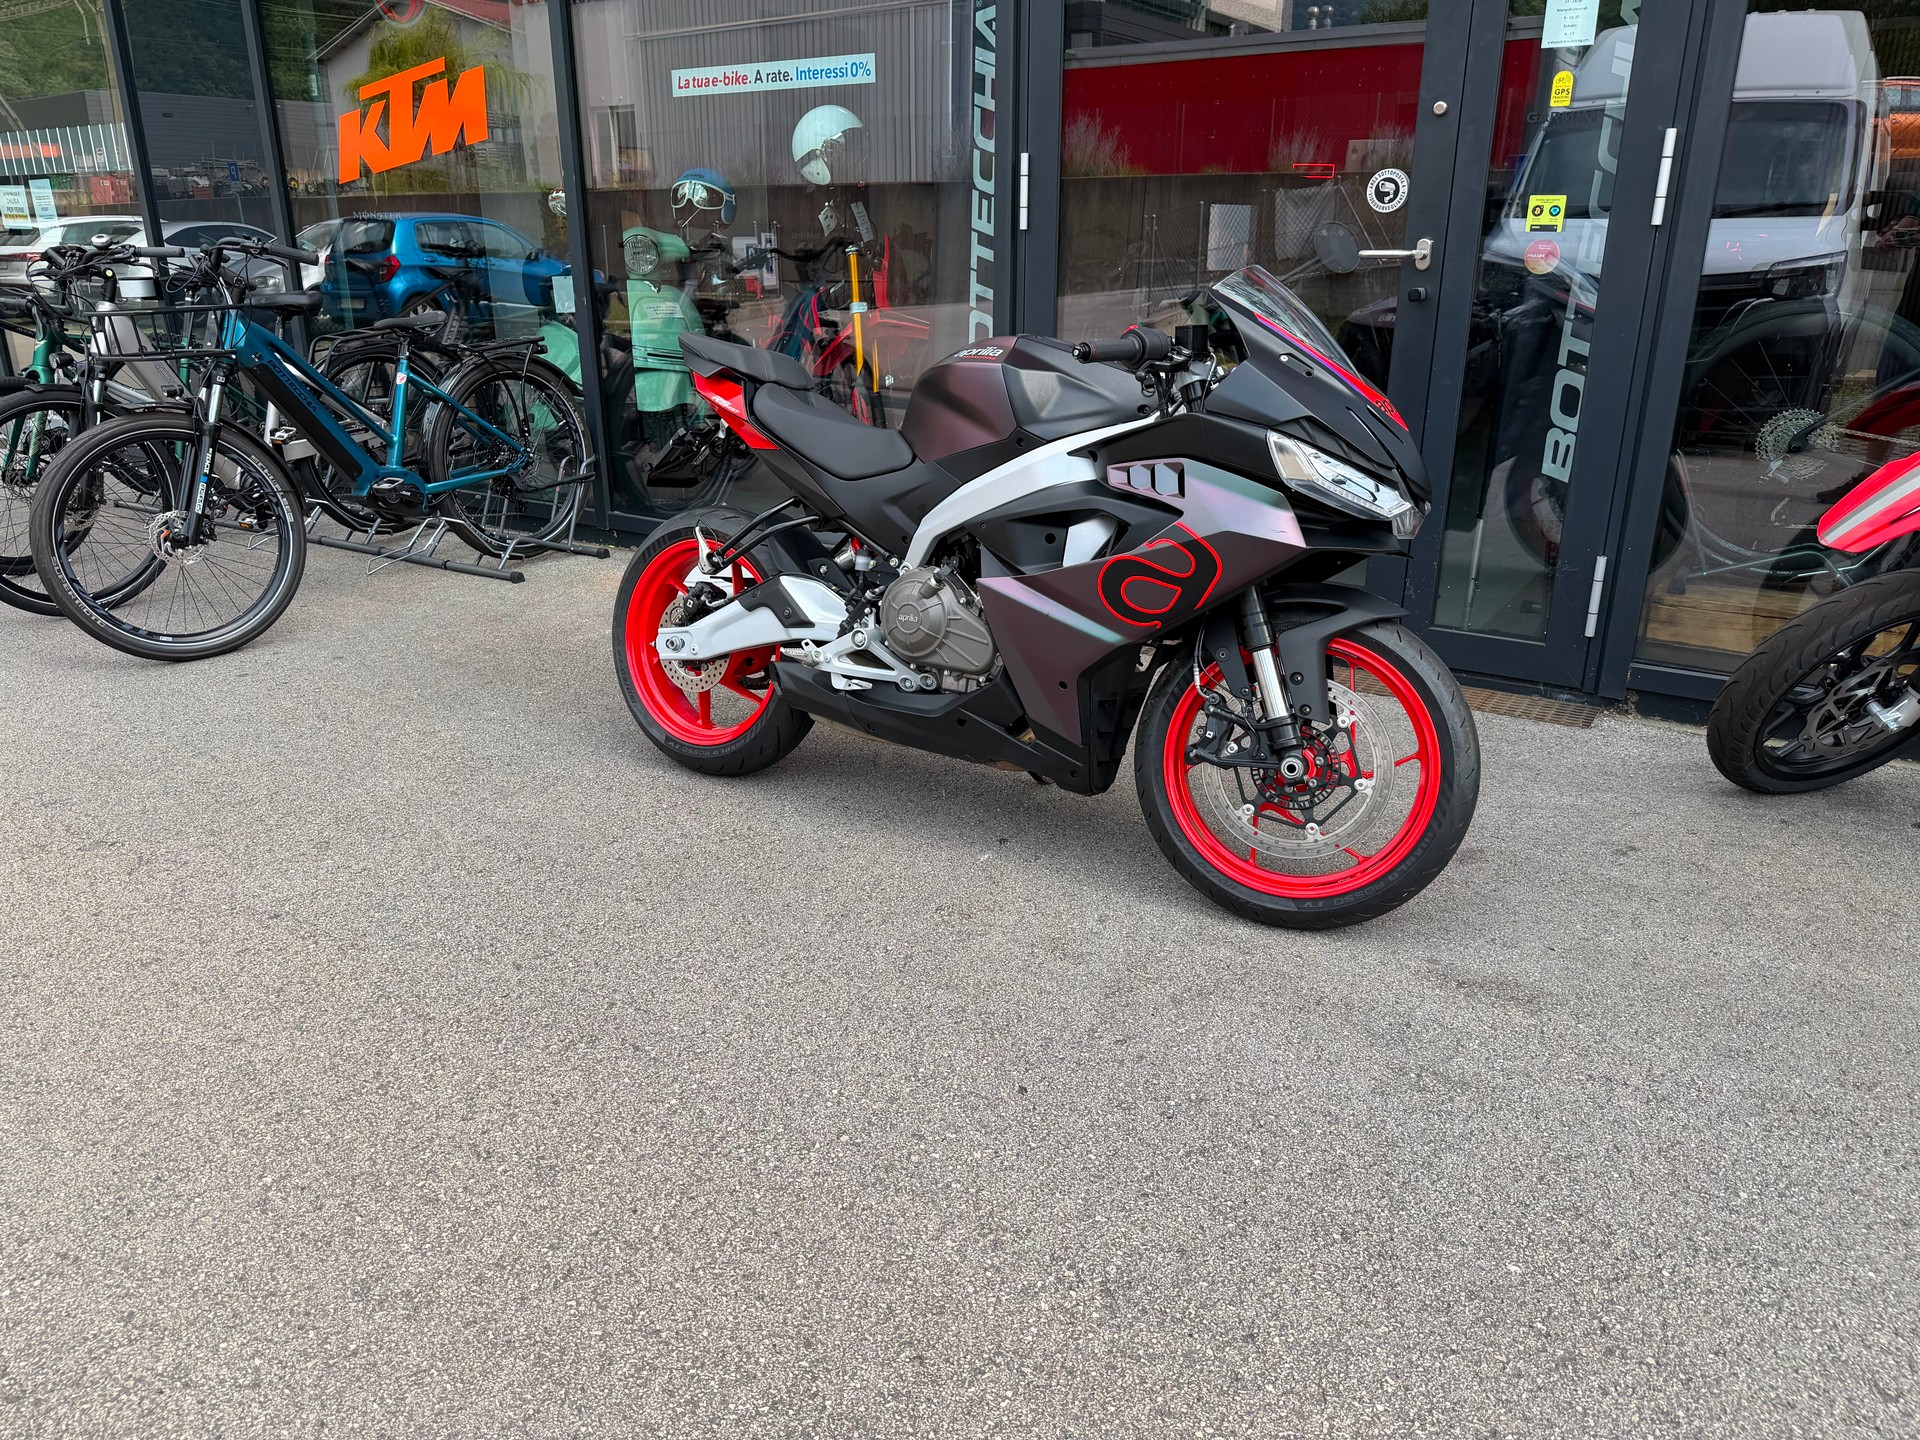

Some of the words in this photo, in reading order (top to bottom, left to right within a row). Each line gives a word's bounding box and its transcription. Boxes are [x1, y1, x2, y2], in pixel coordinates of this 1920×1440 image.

[677, 75, 690, 90] La
[692, 75, 710, 89] tua
[711, 70, 752, 87] e-bike.
[754, 69, 763, 84] A
[766, 69, 793, 83] rate.
[795, 62, 848, 81] Interessi
[850, 60, 871, 78] 0%
[1554, 88, 1570, 96] GPS
[339, 56, 488, 184] KTM
[968, 4, 996, 344] OTTECCHIA
[1368, 176, 1379, 190] AREA
[1377, 170, 1406, 184] SOTTOPOSTA
[954, 346, 1004, 358] aprilia
[267, 359, 318, 413] BOTTECCHIA
